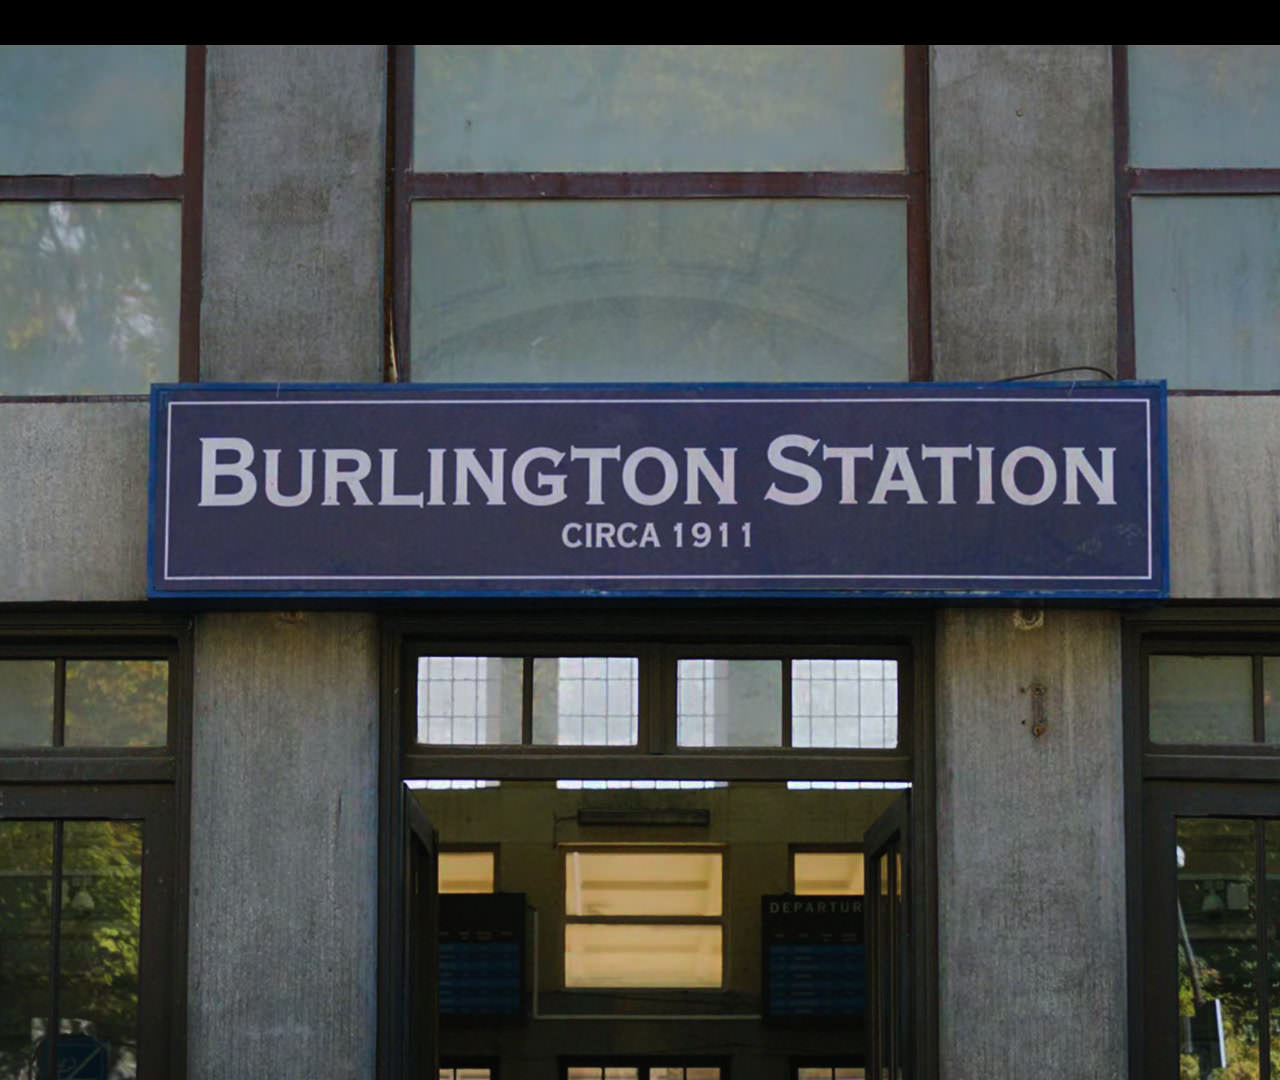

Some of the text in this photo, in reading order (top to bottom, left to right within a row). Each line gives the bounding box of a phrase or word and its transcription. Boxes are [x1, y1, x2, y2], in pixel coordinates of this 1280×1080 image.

[197, 433, 1118, 508] BURLINGTON STATION
[561, 521, 752, 549] CIRCA 1911
